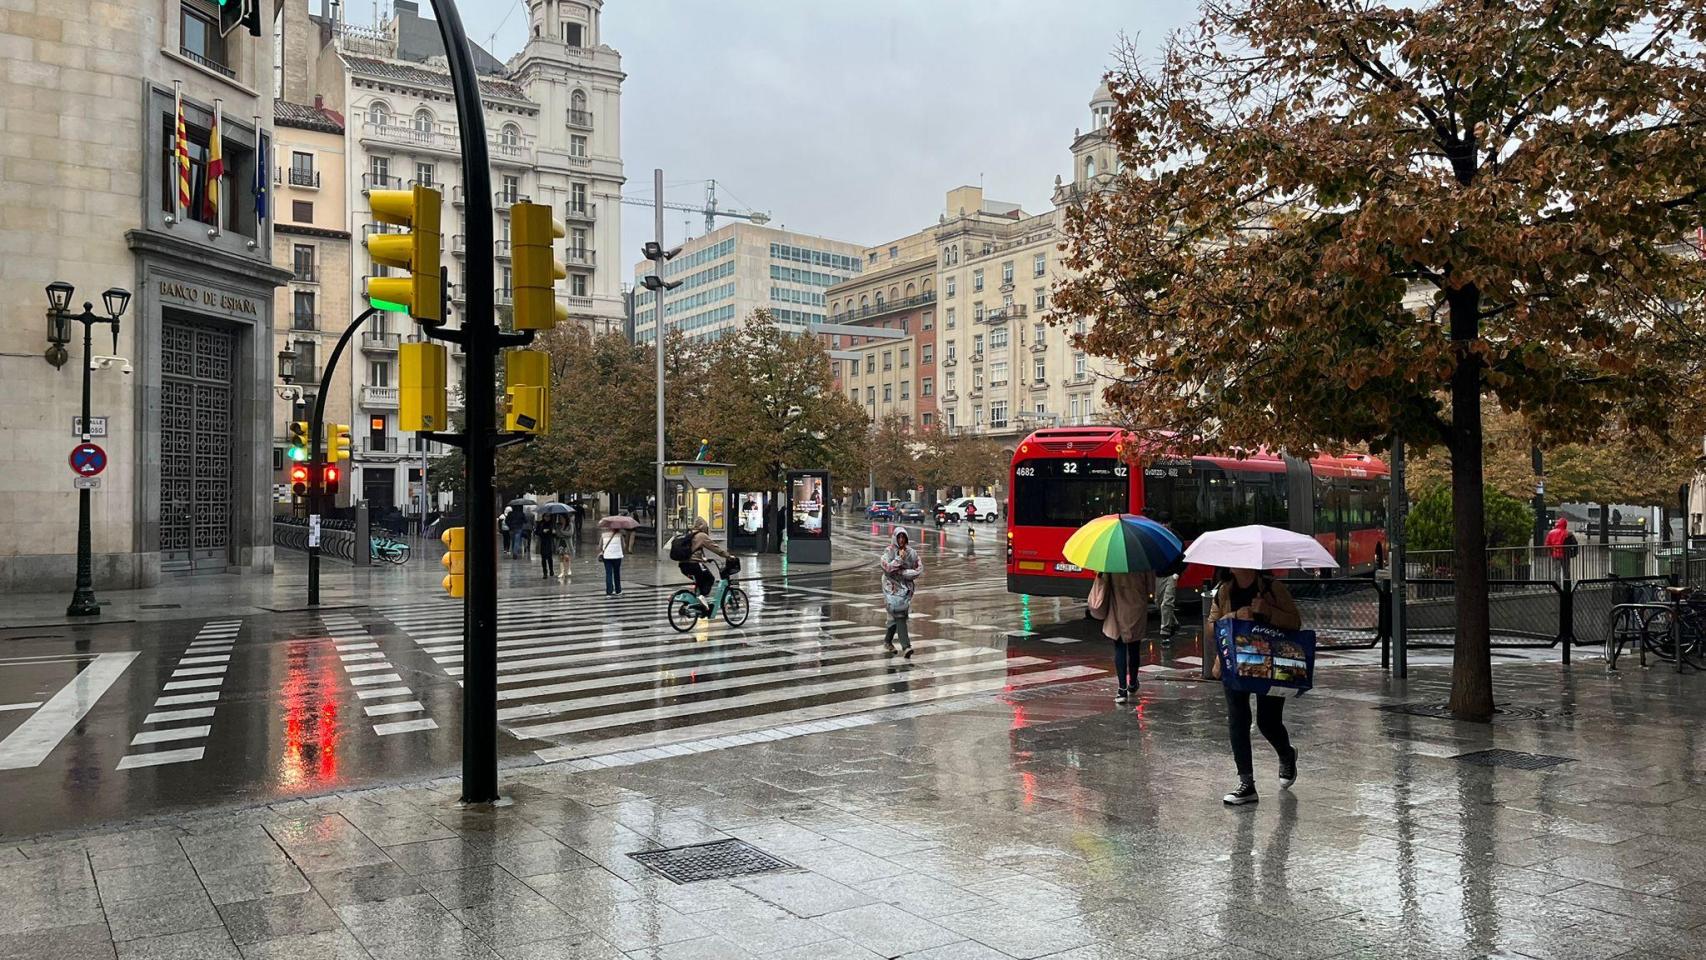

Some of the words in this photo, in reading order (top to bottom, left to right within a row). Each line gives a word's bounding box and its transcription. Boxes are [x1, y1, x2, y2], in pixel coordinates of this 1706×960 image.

[160, 281, 198, 302] BANCO
[203, 290, 217, 306] DE
[220, 294, 257, 315] ESPAÑA
[1016, 467, 1035, 477] 4682
[1063, 462, 1077, 473] 32
